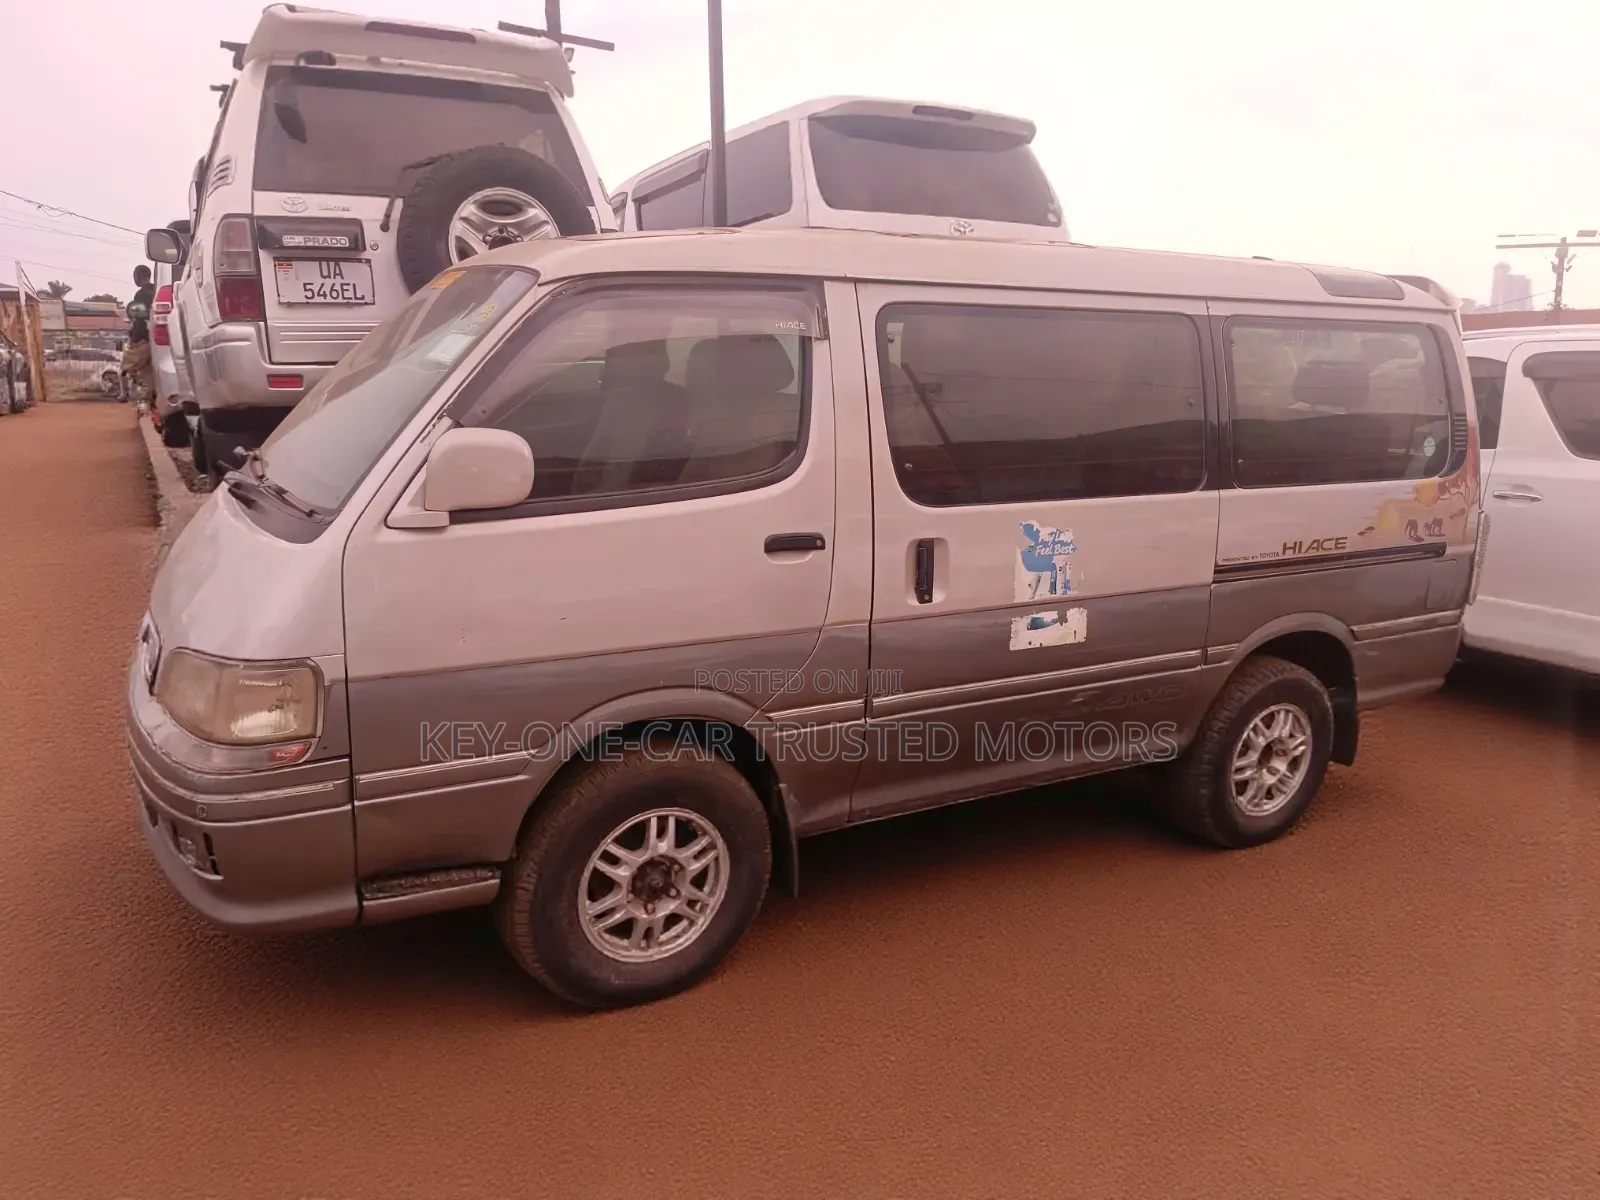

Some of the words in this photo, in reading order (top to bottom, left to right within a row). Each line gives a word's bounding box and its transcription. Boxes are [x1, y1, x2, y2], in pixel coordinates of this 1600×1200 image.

[302, 236, 348, 246] PRADO
[318, 260, 344, 280] UA
[303, 282, 365, 301] 546EL
[1036, 544, 1053, 557] Feel
[1054, 543, 1075, 554] Best
[1259, 551, 1280, 559] TOYOTA
